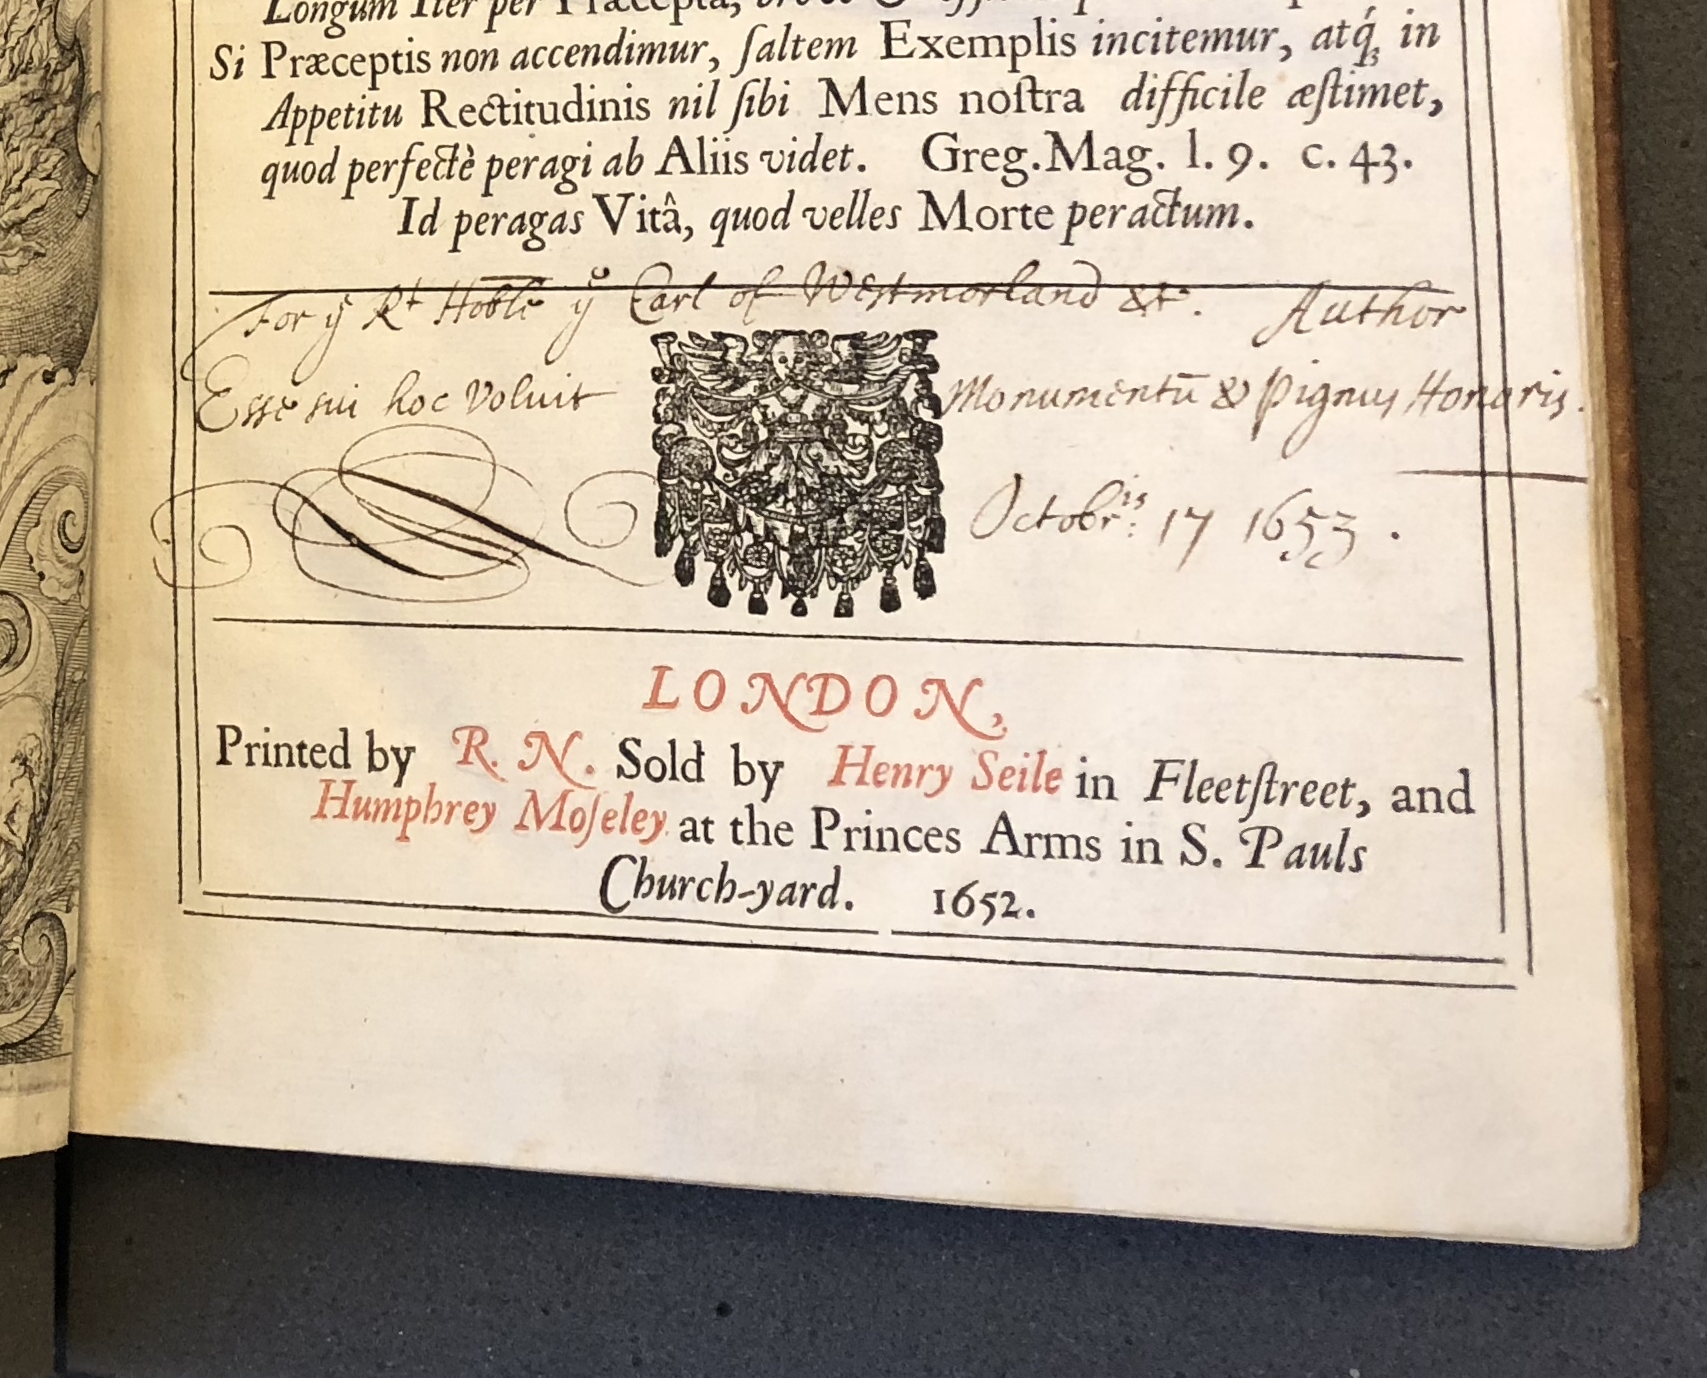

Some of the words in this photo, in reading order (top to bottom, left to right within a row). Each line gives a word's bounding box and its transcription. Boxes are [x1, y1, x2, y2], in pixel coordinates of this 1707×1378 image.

[209, 43, 246, 82] Si
[261, 39, 430, 91] Præceptis
[441, 46, 500, 74] non
[510, 27, 720, 73] accendimur,
[880, 17, 1076, 73] Exemplis
[1092, 19, 1292, 62] incitemur,
[1399, 9, 1441, 51] in
[262, 92, 402, 147] Appetitu
[420, 84, 651, 129] Rectitudinis
[668, 80, 718, 121] nil
[818, 77, 939, 119] Mens
[1120, 70, 1267, 128] difficile
[261, 146, 339, 200] quod
[342, 141, 475, 200] perfectè
[485, 140, 592, 197] peragi
[604, 136, 644, 177] ab
[655, 135, 751, 178] Aliis
[759, 134, 868, 176] videt.
[1228, 141, 1269, 182] 9.
[1301, 144, 1337, 171] c.
[1349, 139, 1414, 185] 43.
[398, 196, 439, 237] Id
[448, 205, 584, 253] peragas
[592, 191, 694, 243] Vitâ,
[709, 192, 796, 248] quod
[801, 189, 903, 232] velles
[918, 189, 1056, 233] Morte
[1060, 186, 1254, 246] peractum.
[729, 265, 796, 326] of
[1252, 279, 1467, 348] Author
[386, 370, 450, 417] hoc
[1210, 374, 1250, 410] &
[1159, 506, 1215, 572] 17
[643, 665, 1008, 741] LONDON,
[216, 724, 350, 771] Printed
[367, 734, 416, 788] by
[451, 725, 506, 782] R.
[517, 729, 596, 789] N.
[616, 738, 705, 784] Sold
[732, 743, 784, 801] by
[828, 743, 954, 797] Henry
[970, 746, 1064, 795] Seile
[1075, 757, 1118, 802] in
[1392, 769, 1475, 816] and
[311, 779, 498, 843] Humphrey
[679, 815, 715, 843] at
[730, 807, 794, 848] the
[811, 806, 961, 856] Princes
[980, 810, 1102, 863] Arms
[1120, 821, 1162, 866] in
[1180, 823, 1223, 869] S.
[1239, 825, 1365, 874] Pauls
[600, 854, 854, 913] Church-yard.
[933, 880, 1036, 926] 1652.
